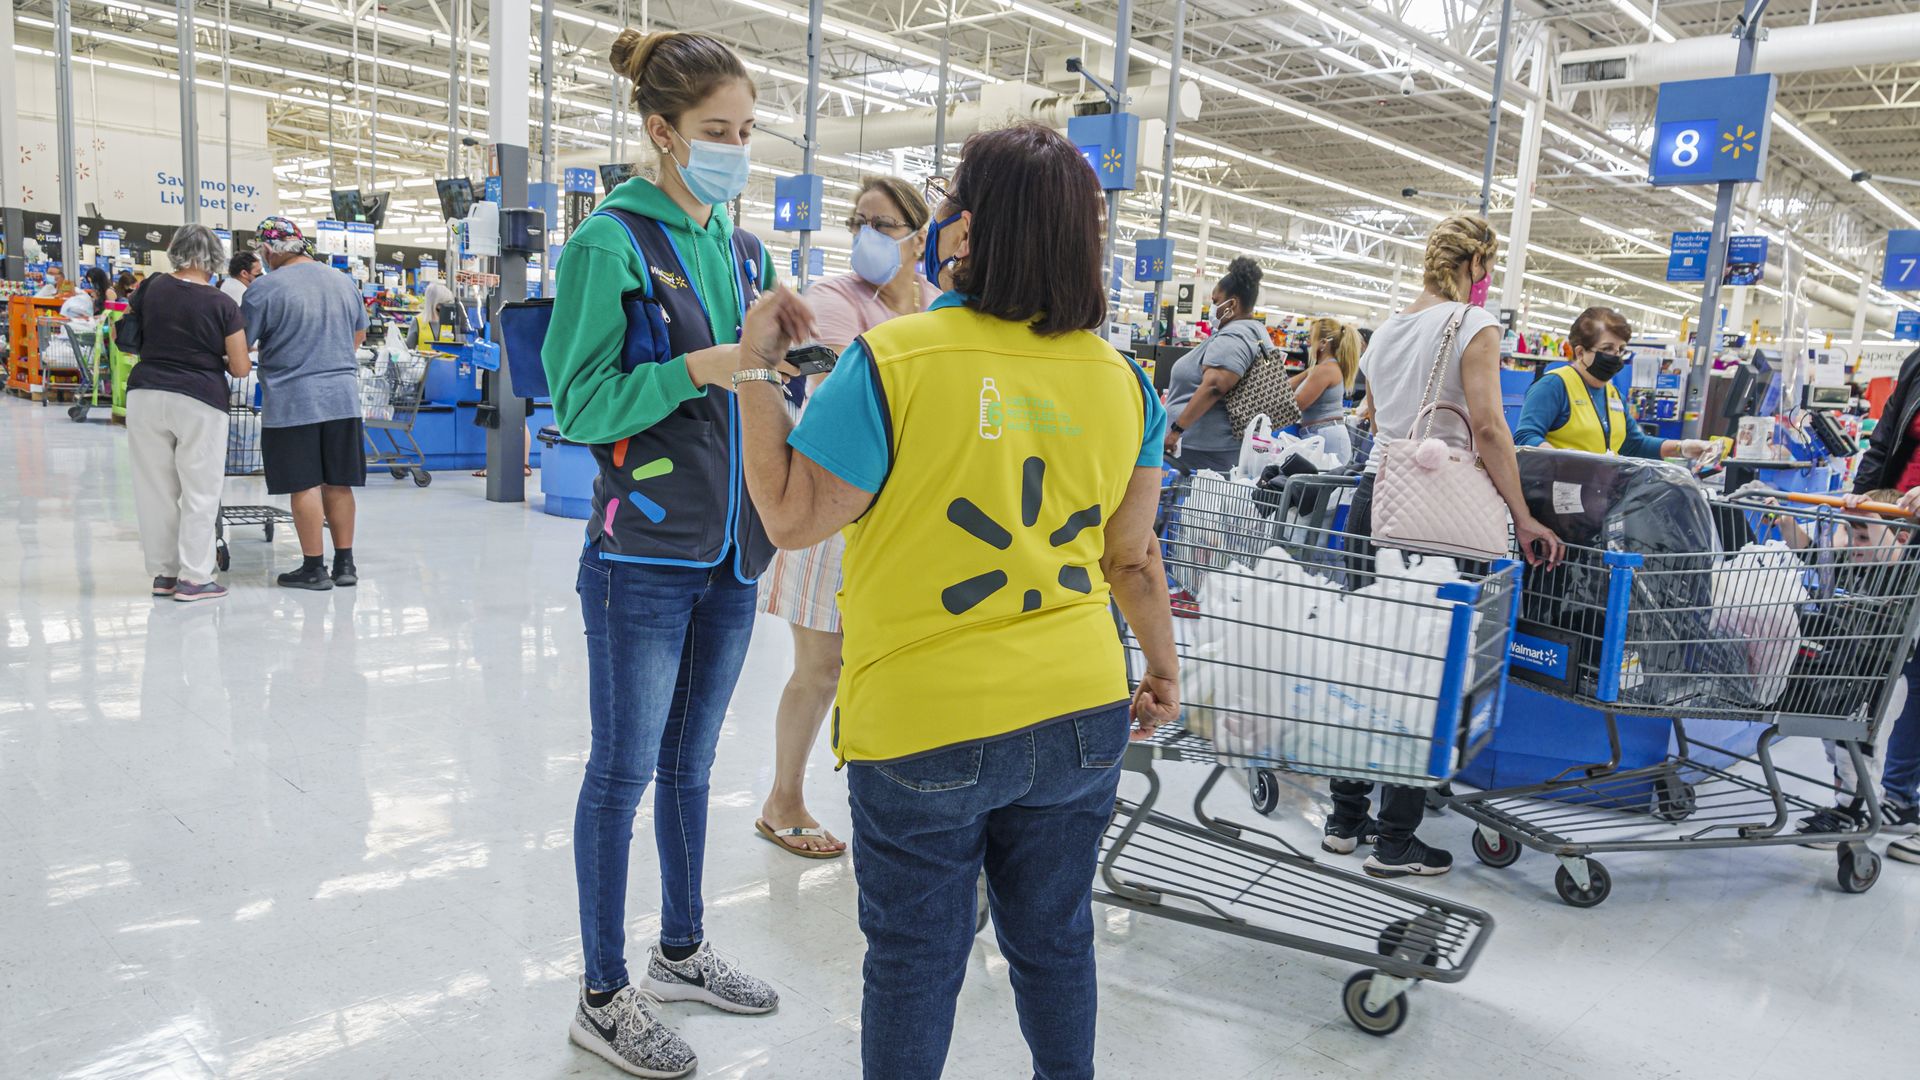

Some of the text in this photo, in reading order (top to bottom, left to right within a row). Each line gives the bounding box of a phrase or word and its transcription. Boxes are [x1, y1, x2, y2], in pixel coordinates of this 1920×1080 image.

[1672, 129, 1700, 167] 8
[157, 171, 260, 198] Sav money.
[160, 190, 255, 213] Liv beter.
[584, 196, 593, 217] Scan
[780, 202, 791, 222] 4
[1139, 259, 1147, 275] 3
[1899, 259, 1917, 282] 7
[988, 401, 1004, 427] 6
